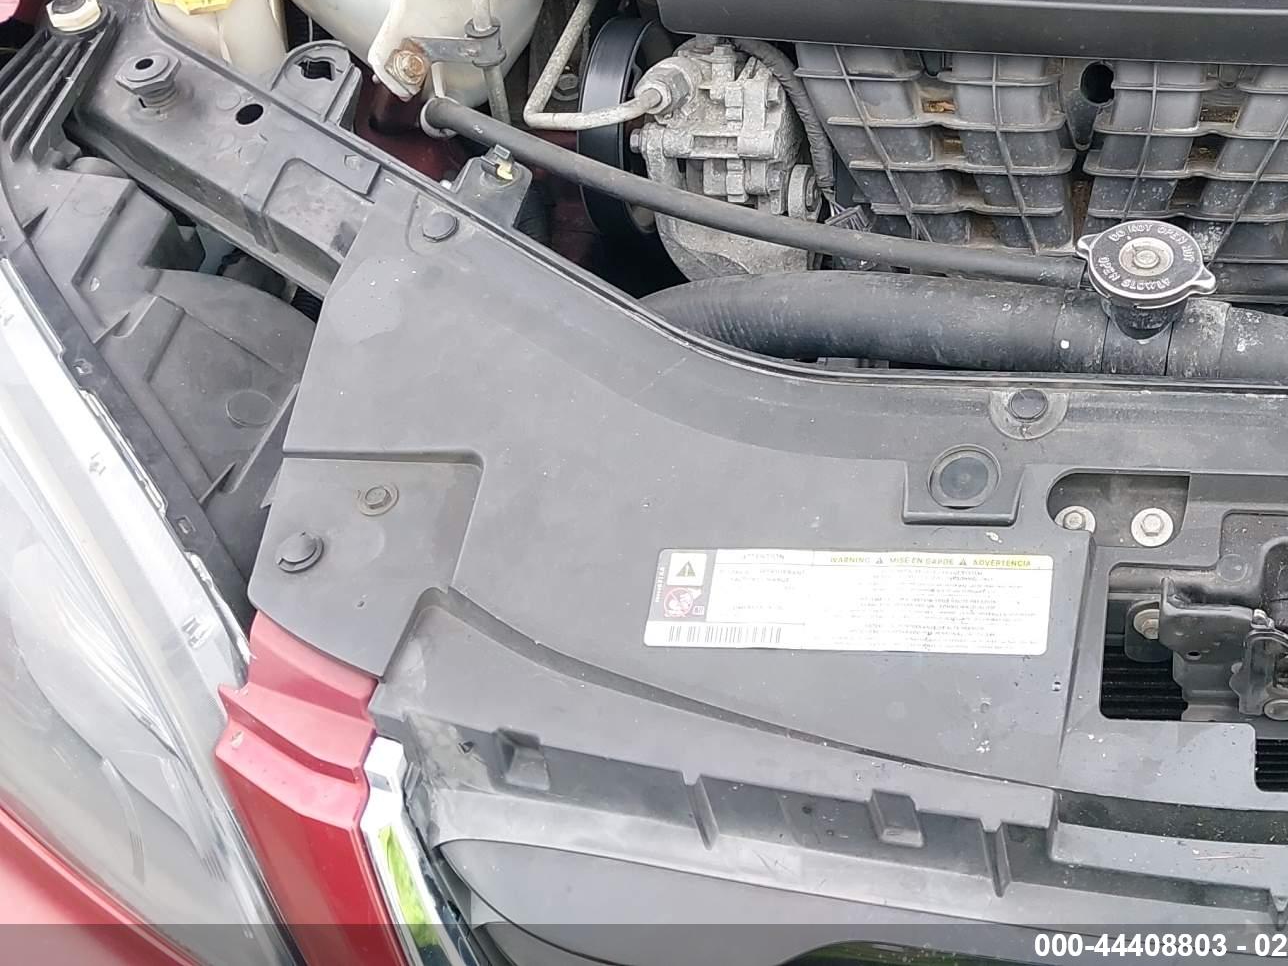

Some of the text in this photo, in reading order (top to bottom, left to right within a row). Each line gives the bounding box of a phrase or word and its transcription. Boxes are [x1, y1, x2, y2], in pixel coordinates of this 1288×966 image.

[1108, 229, 1126, 242] DO
[1127, 223, 1153, 233] NOT
[1157, 225, 1188, 244] OPEN
[1098, 257, 1121, 281] OPEN
[972, 559, 1032, 567] ADVERTENCIA
